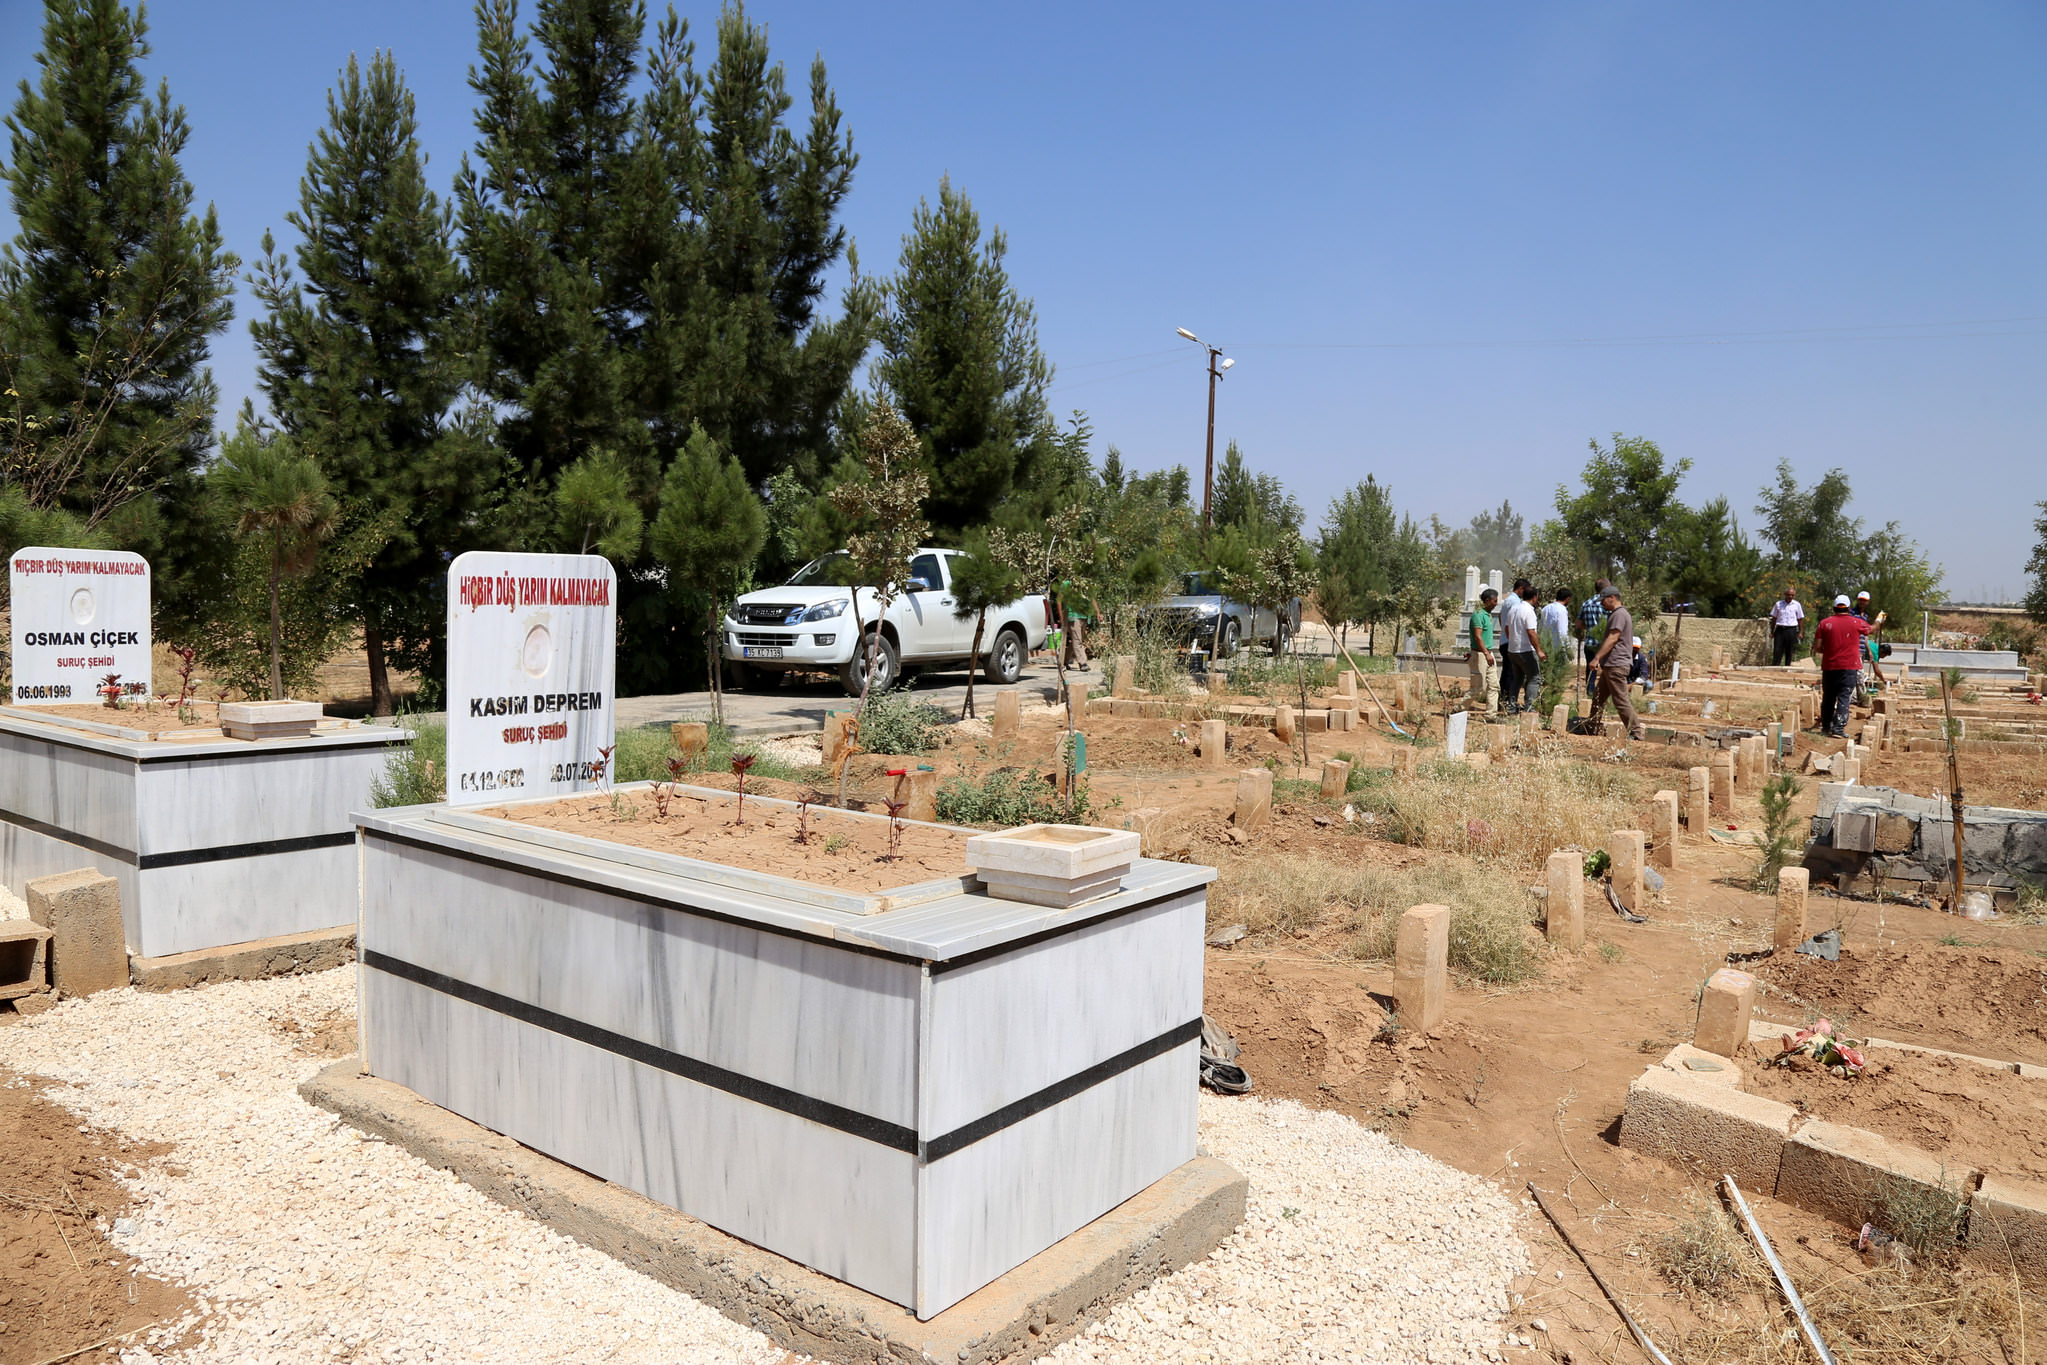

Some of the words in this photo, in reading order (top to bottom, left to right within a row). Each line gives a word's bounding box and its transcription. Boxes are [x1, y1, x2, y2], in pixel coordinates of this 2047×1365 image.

[46, 558, 63, 576] DÜŞ
[65, 561, 91, 574] YARIM
[93, 561, 146, 576] KALMAYACAK
[496, 570, 516, 613] DÜŞ
[518, 577, 547, 606] YARIM
[550, 578, 610, 606] KALMAYACAK
[24, 632, 85, 646] OSMAN
[90, 629, 139, 648] ÇİÇEK
[56, 657, 86, 669] SURUÇ
[88, 654, 115, 669] ŞEHİDİ
[17, 685, 71, 699] 06.06.1993
[470, 695, 528, 717] KASIM
[534, 692, 601, 714] DEPREM
[503, 726, 535, 744] SURUÇ
[537, 720, 567, 744] ŞEHİDİ
